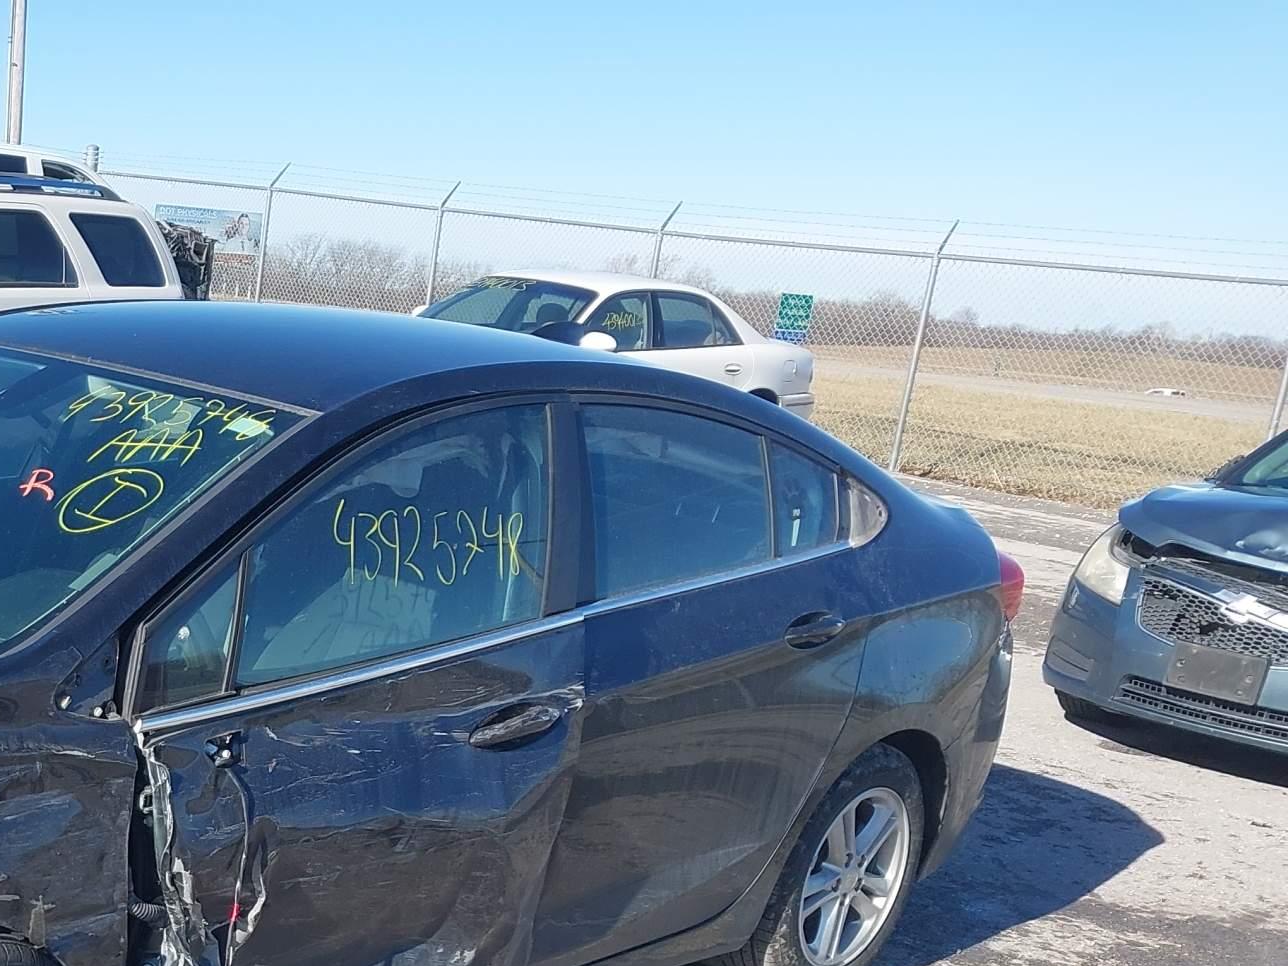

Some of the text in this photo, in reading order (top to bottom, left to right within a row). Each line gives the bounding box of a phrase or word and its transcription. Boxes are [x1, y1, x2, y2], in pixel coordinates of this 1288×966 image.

[86, 427, 204, 468] AAA
[18, 468, 55, 502] R
[332, 498, 526, 588] 43925748
